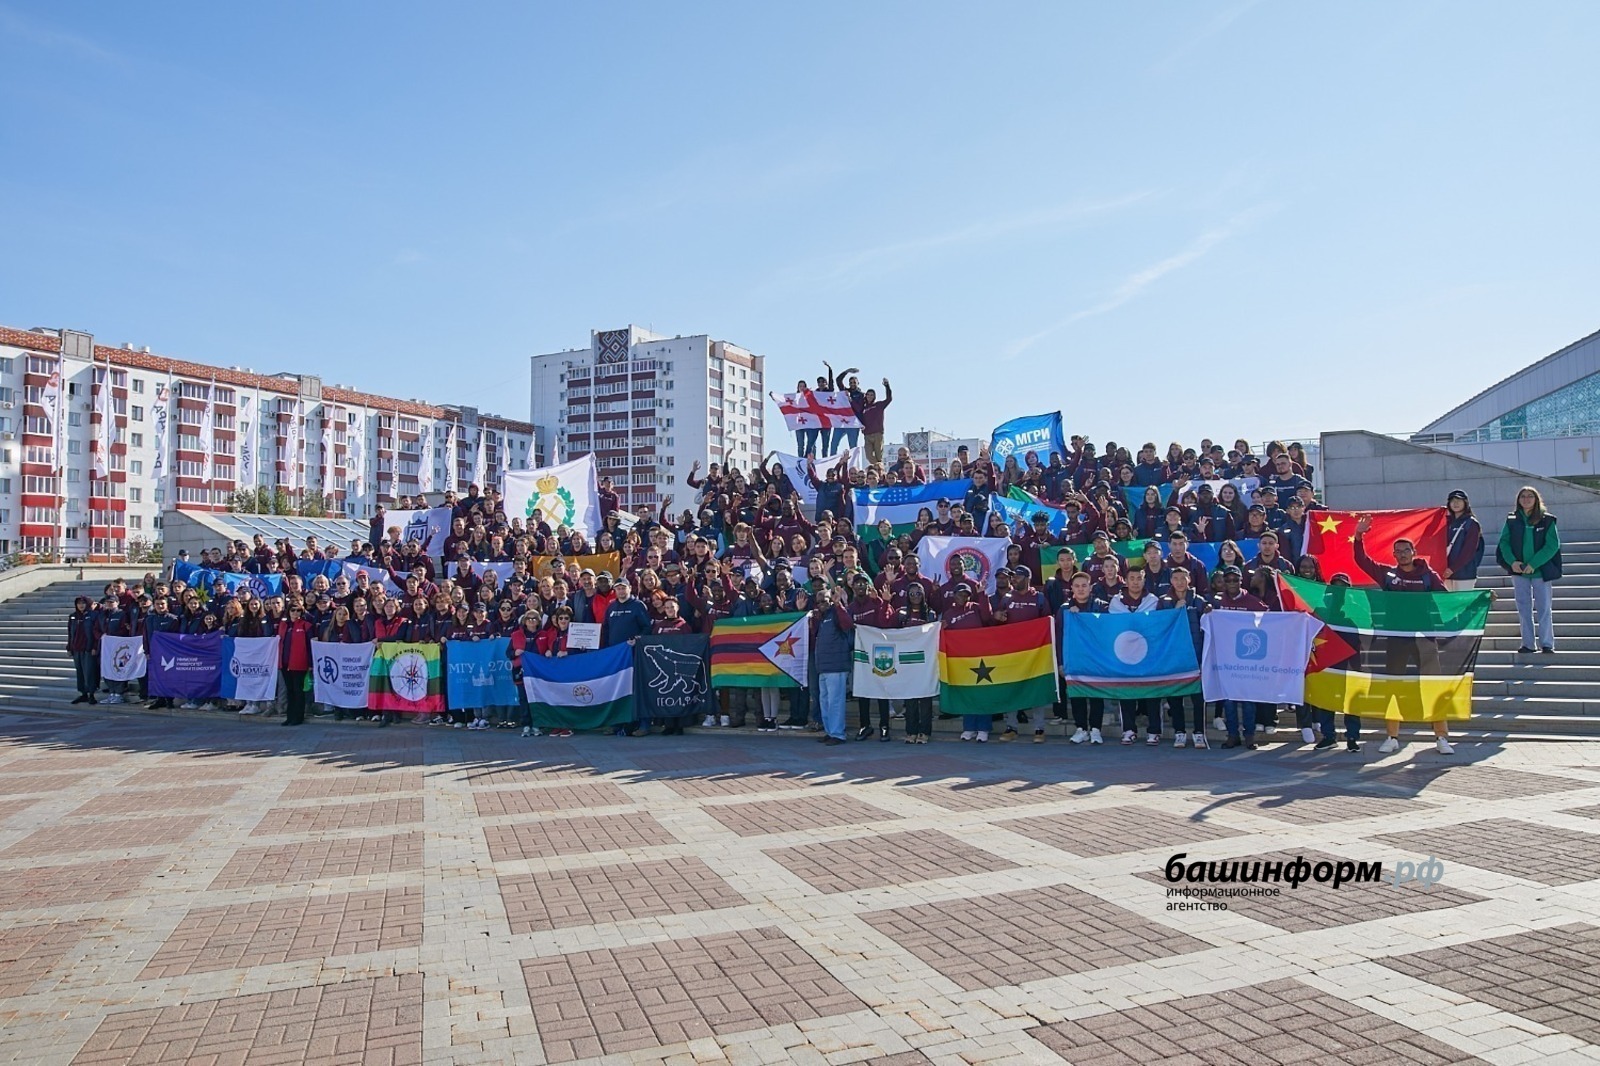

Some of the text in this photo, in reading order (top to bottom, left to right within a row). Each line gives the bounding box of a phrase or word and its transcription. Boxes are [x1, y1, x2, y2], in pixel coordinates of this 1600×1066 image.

[1015, 427, 1051, 446] МГРИ
[448, 662, 476, 674] МГУ
[488, 660, 513, 672] 270
[1259, 664, 1270, 672] de
